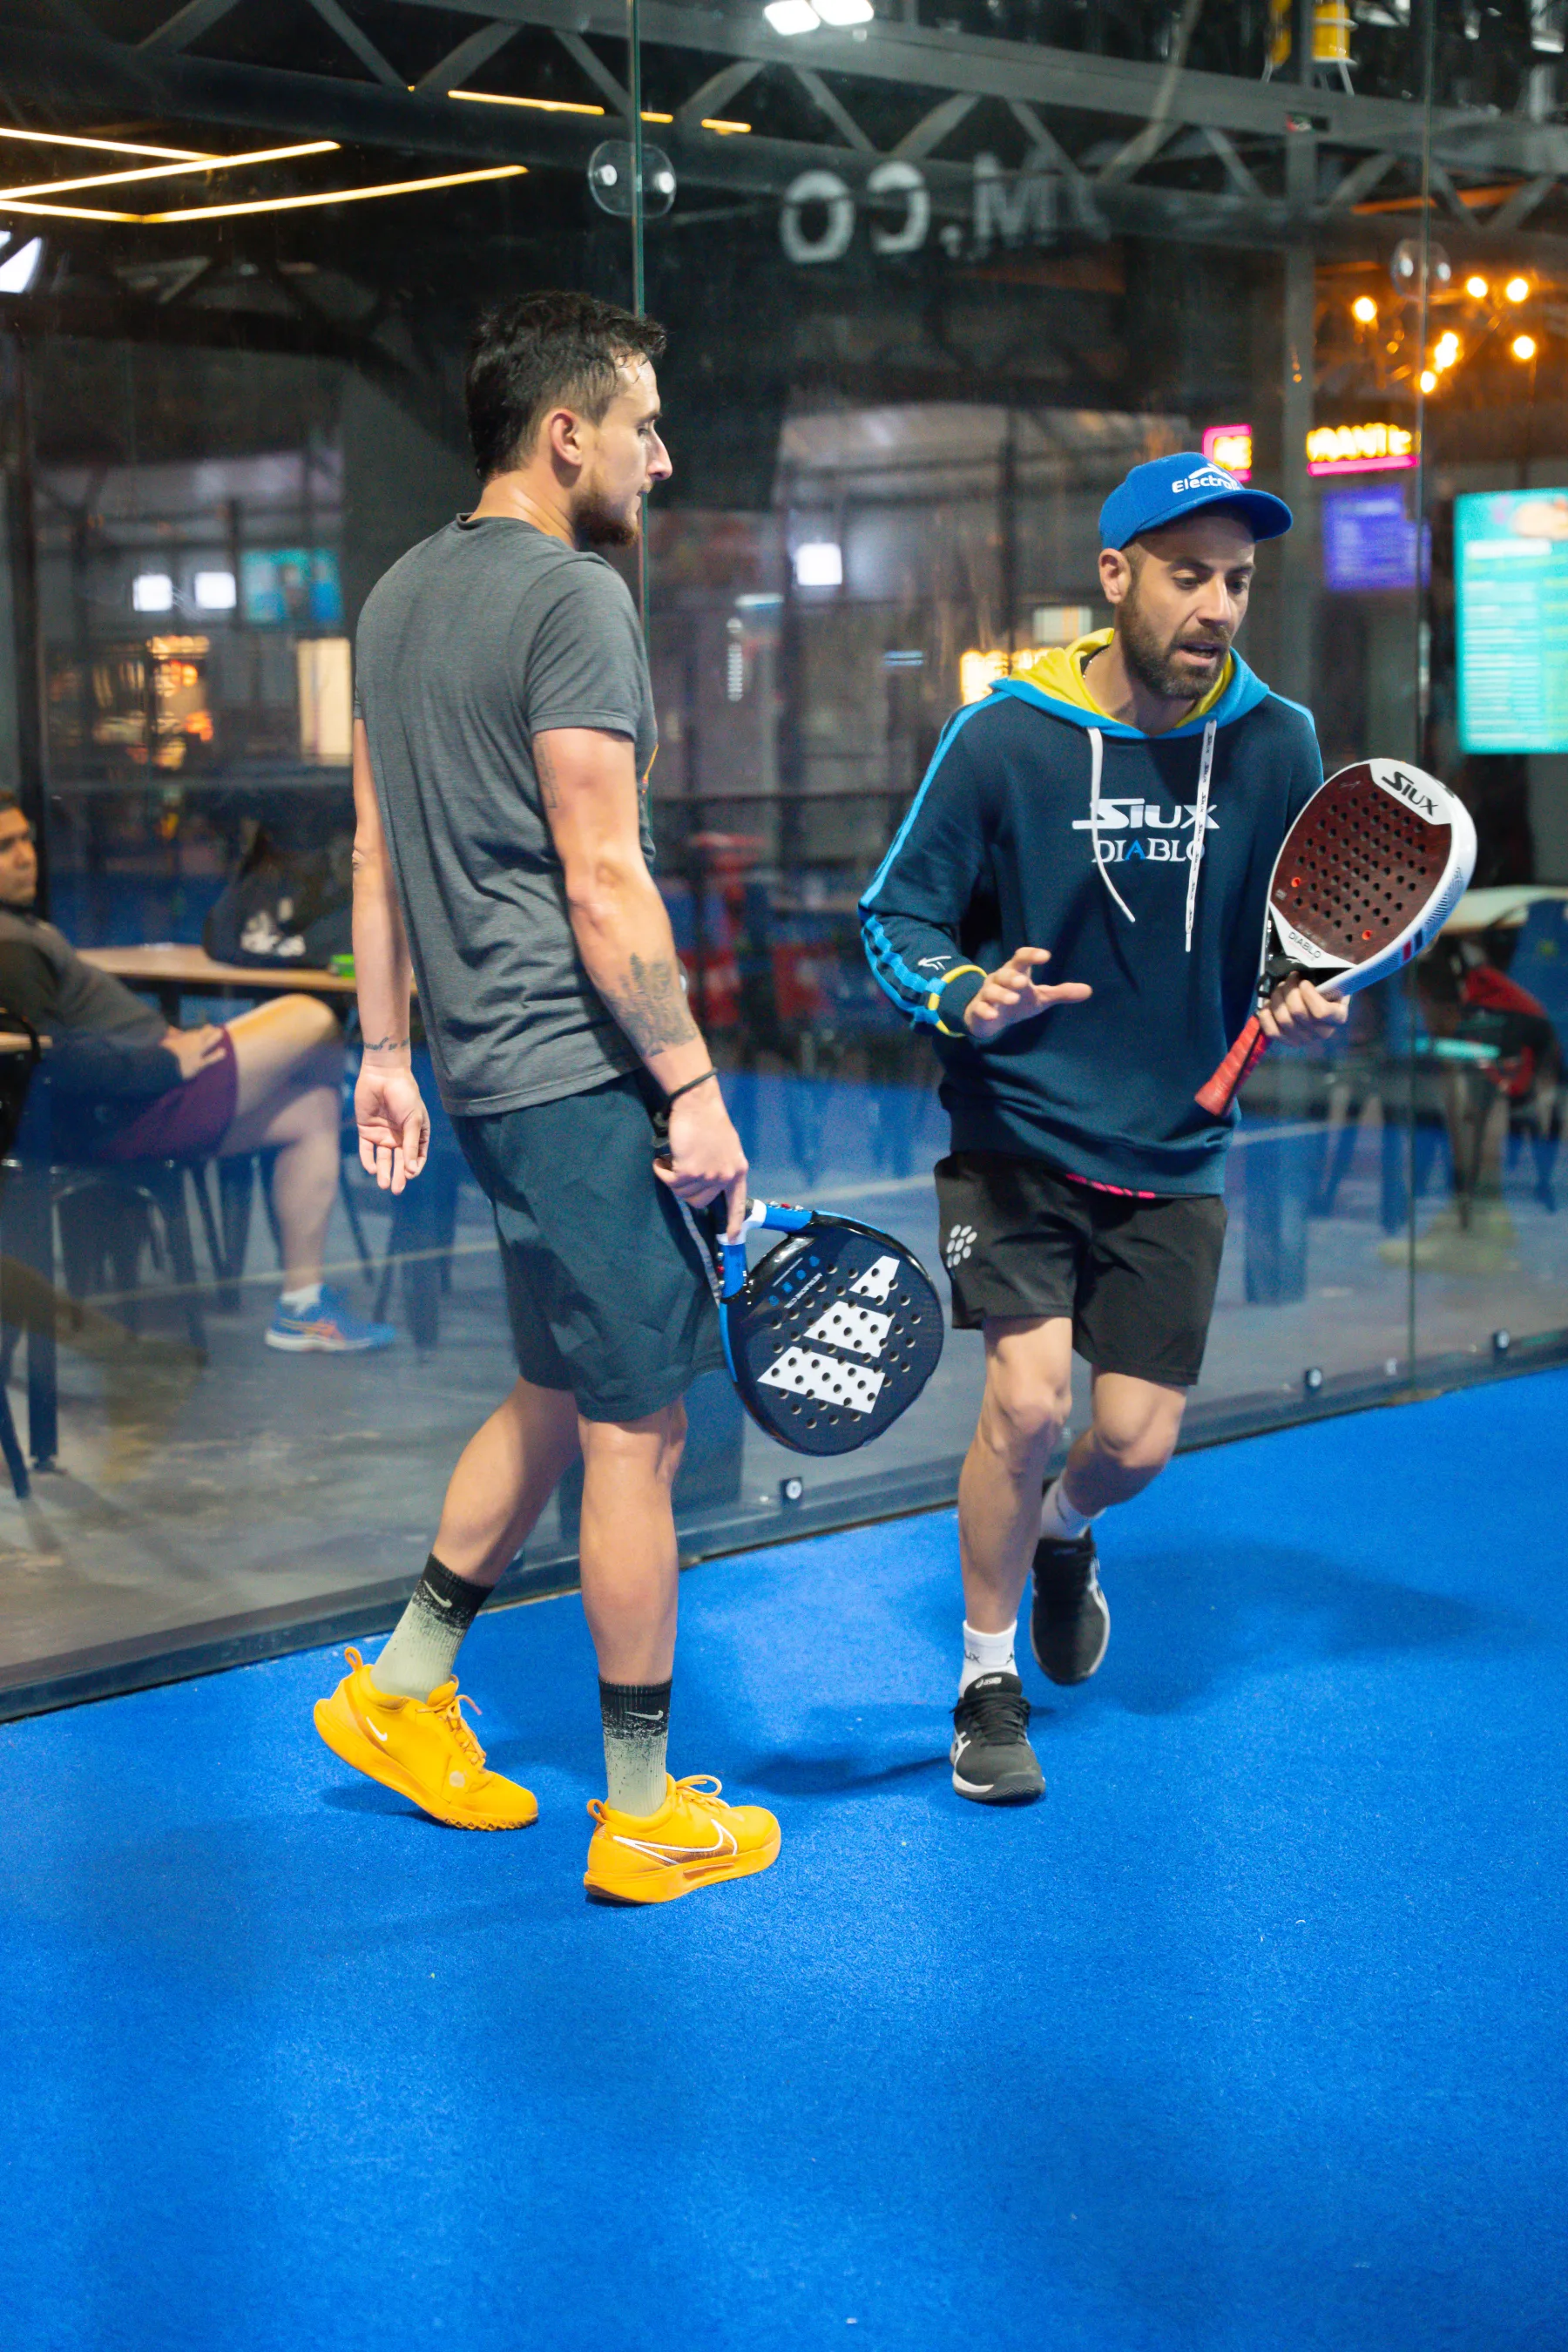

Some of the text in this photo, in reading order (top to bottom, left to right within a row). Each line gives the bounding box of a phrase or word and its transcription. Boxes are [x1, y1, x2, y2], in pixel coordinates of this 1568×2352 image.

[1382, 772, 1438, 817] SIUX
[1071, 798, 1220, 829] SIUX
[1092, 837, 1206, 862] DIABLO
[1288, 931, 1321, 959] DIABLO
